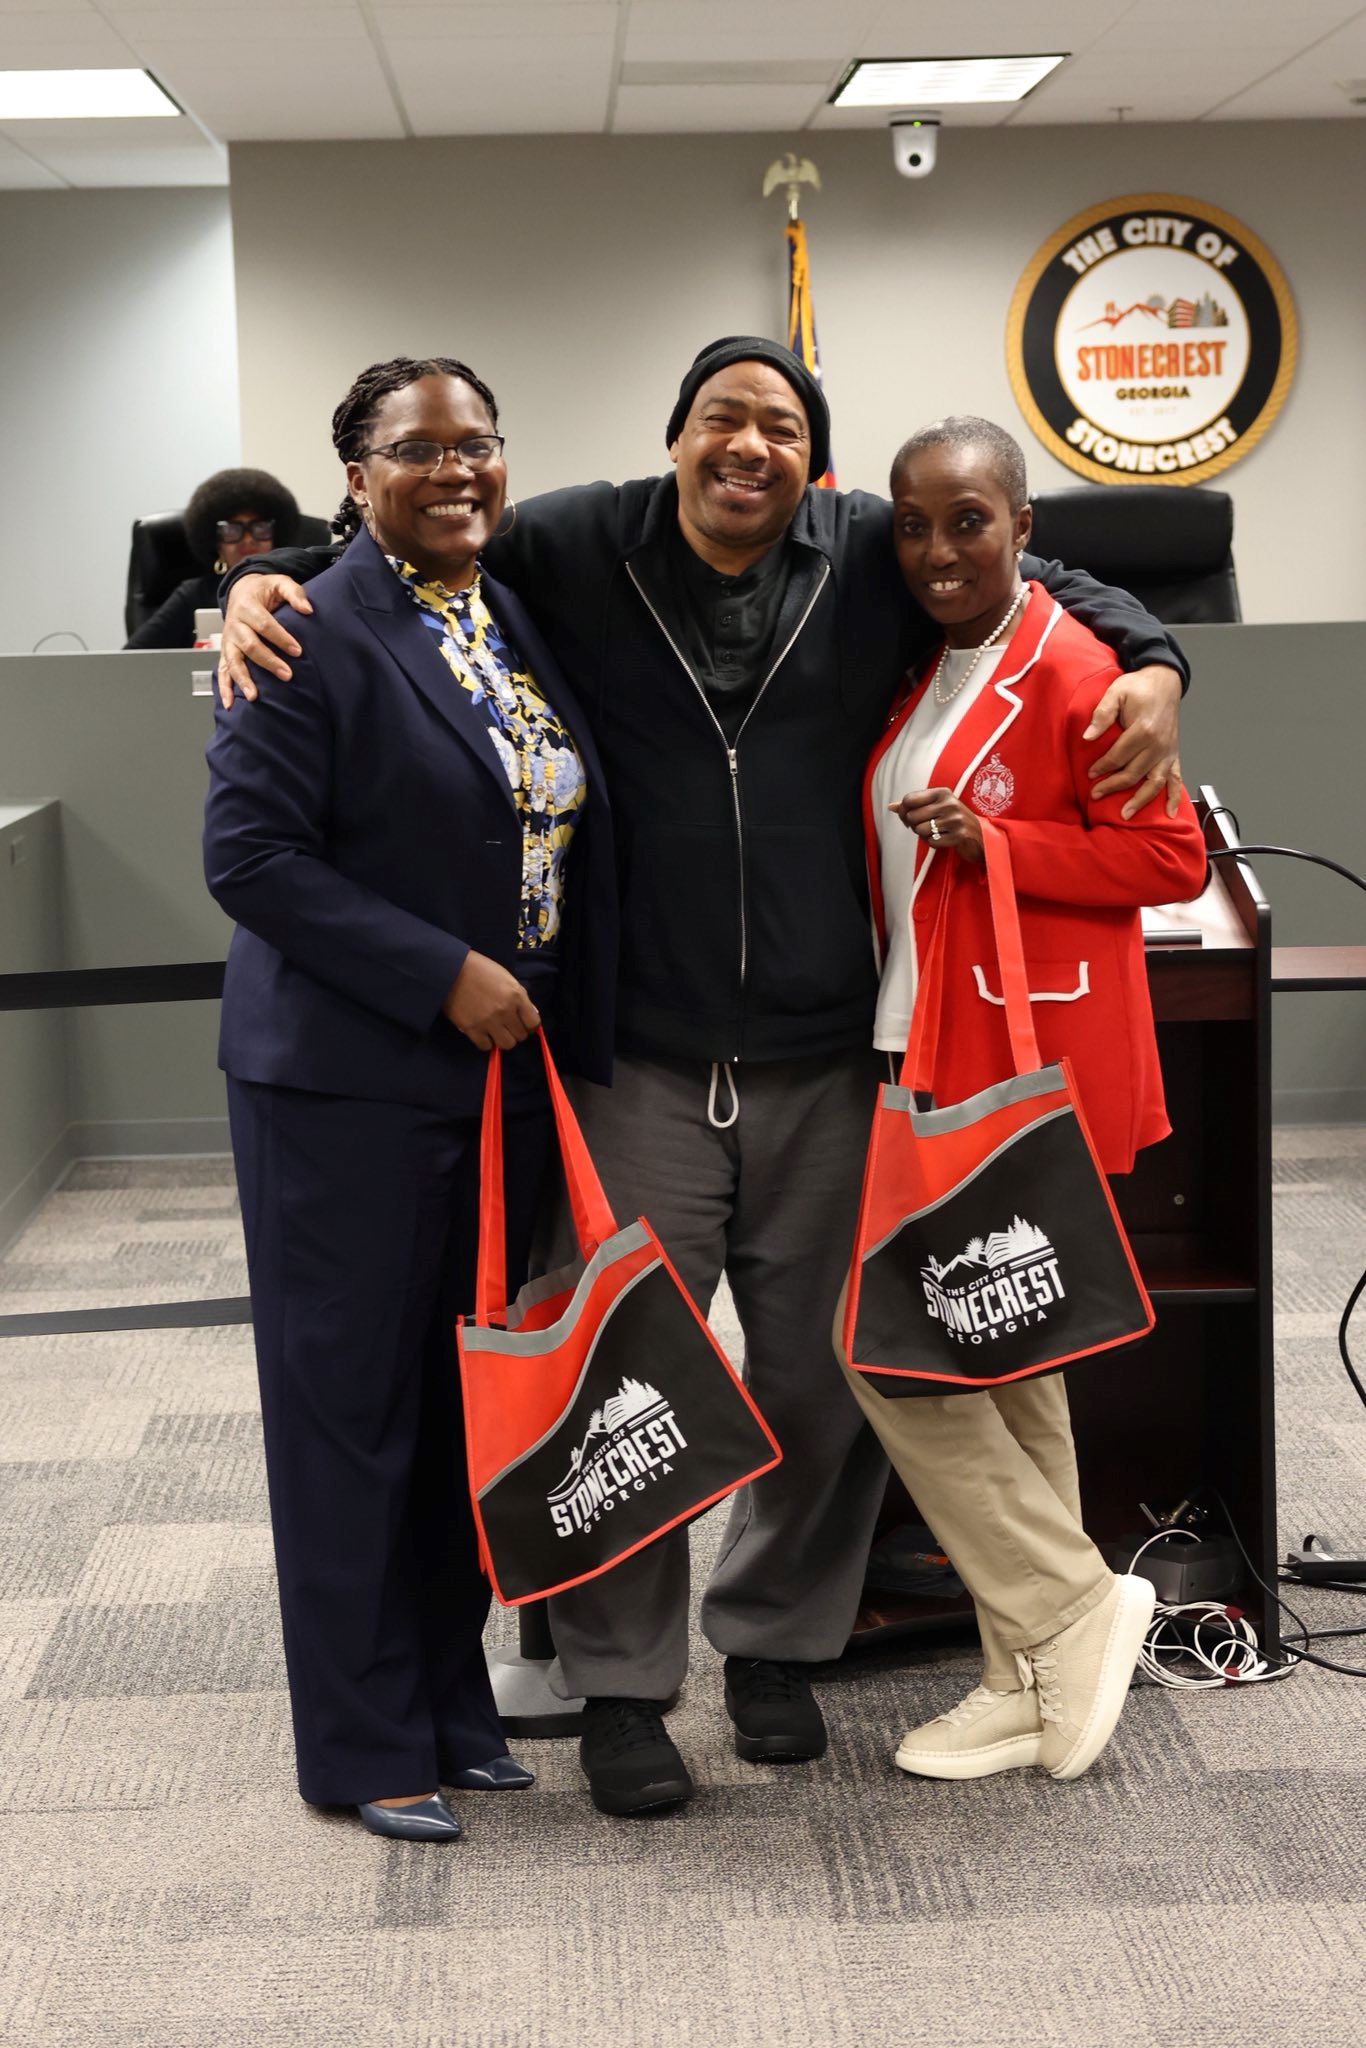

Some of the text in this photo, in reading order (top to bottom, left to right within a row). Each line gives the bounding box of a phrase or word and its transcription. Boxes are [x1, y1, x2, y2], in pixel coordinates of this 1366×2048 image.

[1062, 217, 1239, 274] THE CITY OF
[1077, 341, 1227, 381] STONECREST
[1116, 386, 1190, 400] GEORGIA
[1065, 417, 1238, 473] STONECREST
[923, 1258, 1066, 1334] STONECREST
[946, 1266, 1006, 1297] THE CITY OF
[946, 1309, 1048, 1345] GEORGIA
[549, 1410, 688, 1538] STONECREST
[581, 1428, 626, 1476] THE CITY OF
[583, 1462, 674, 1534] GEORGIA
